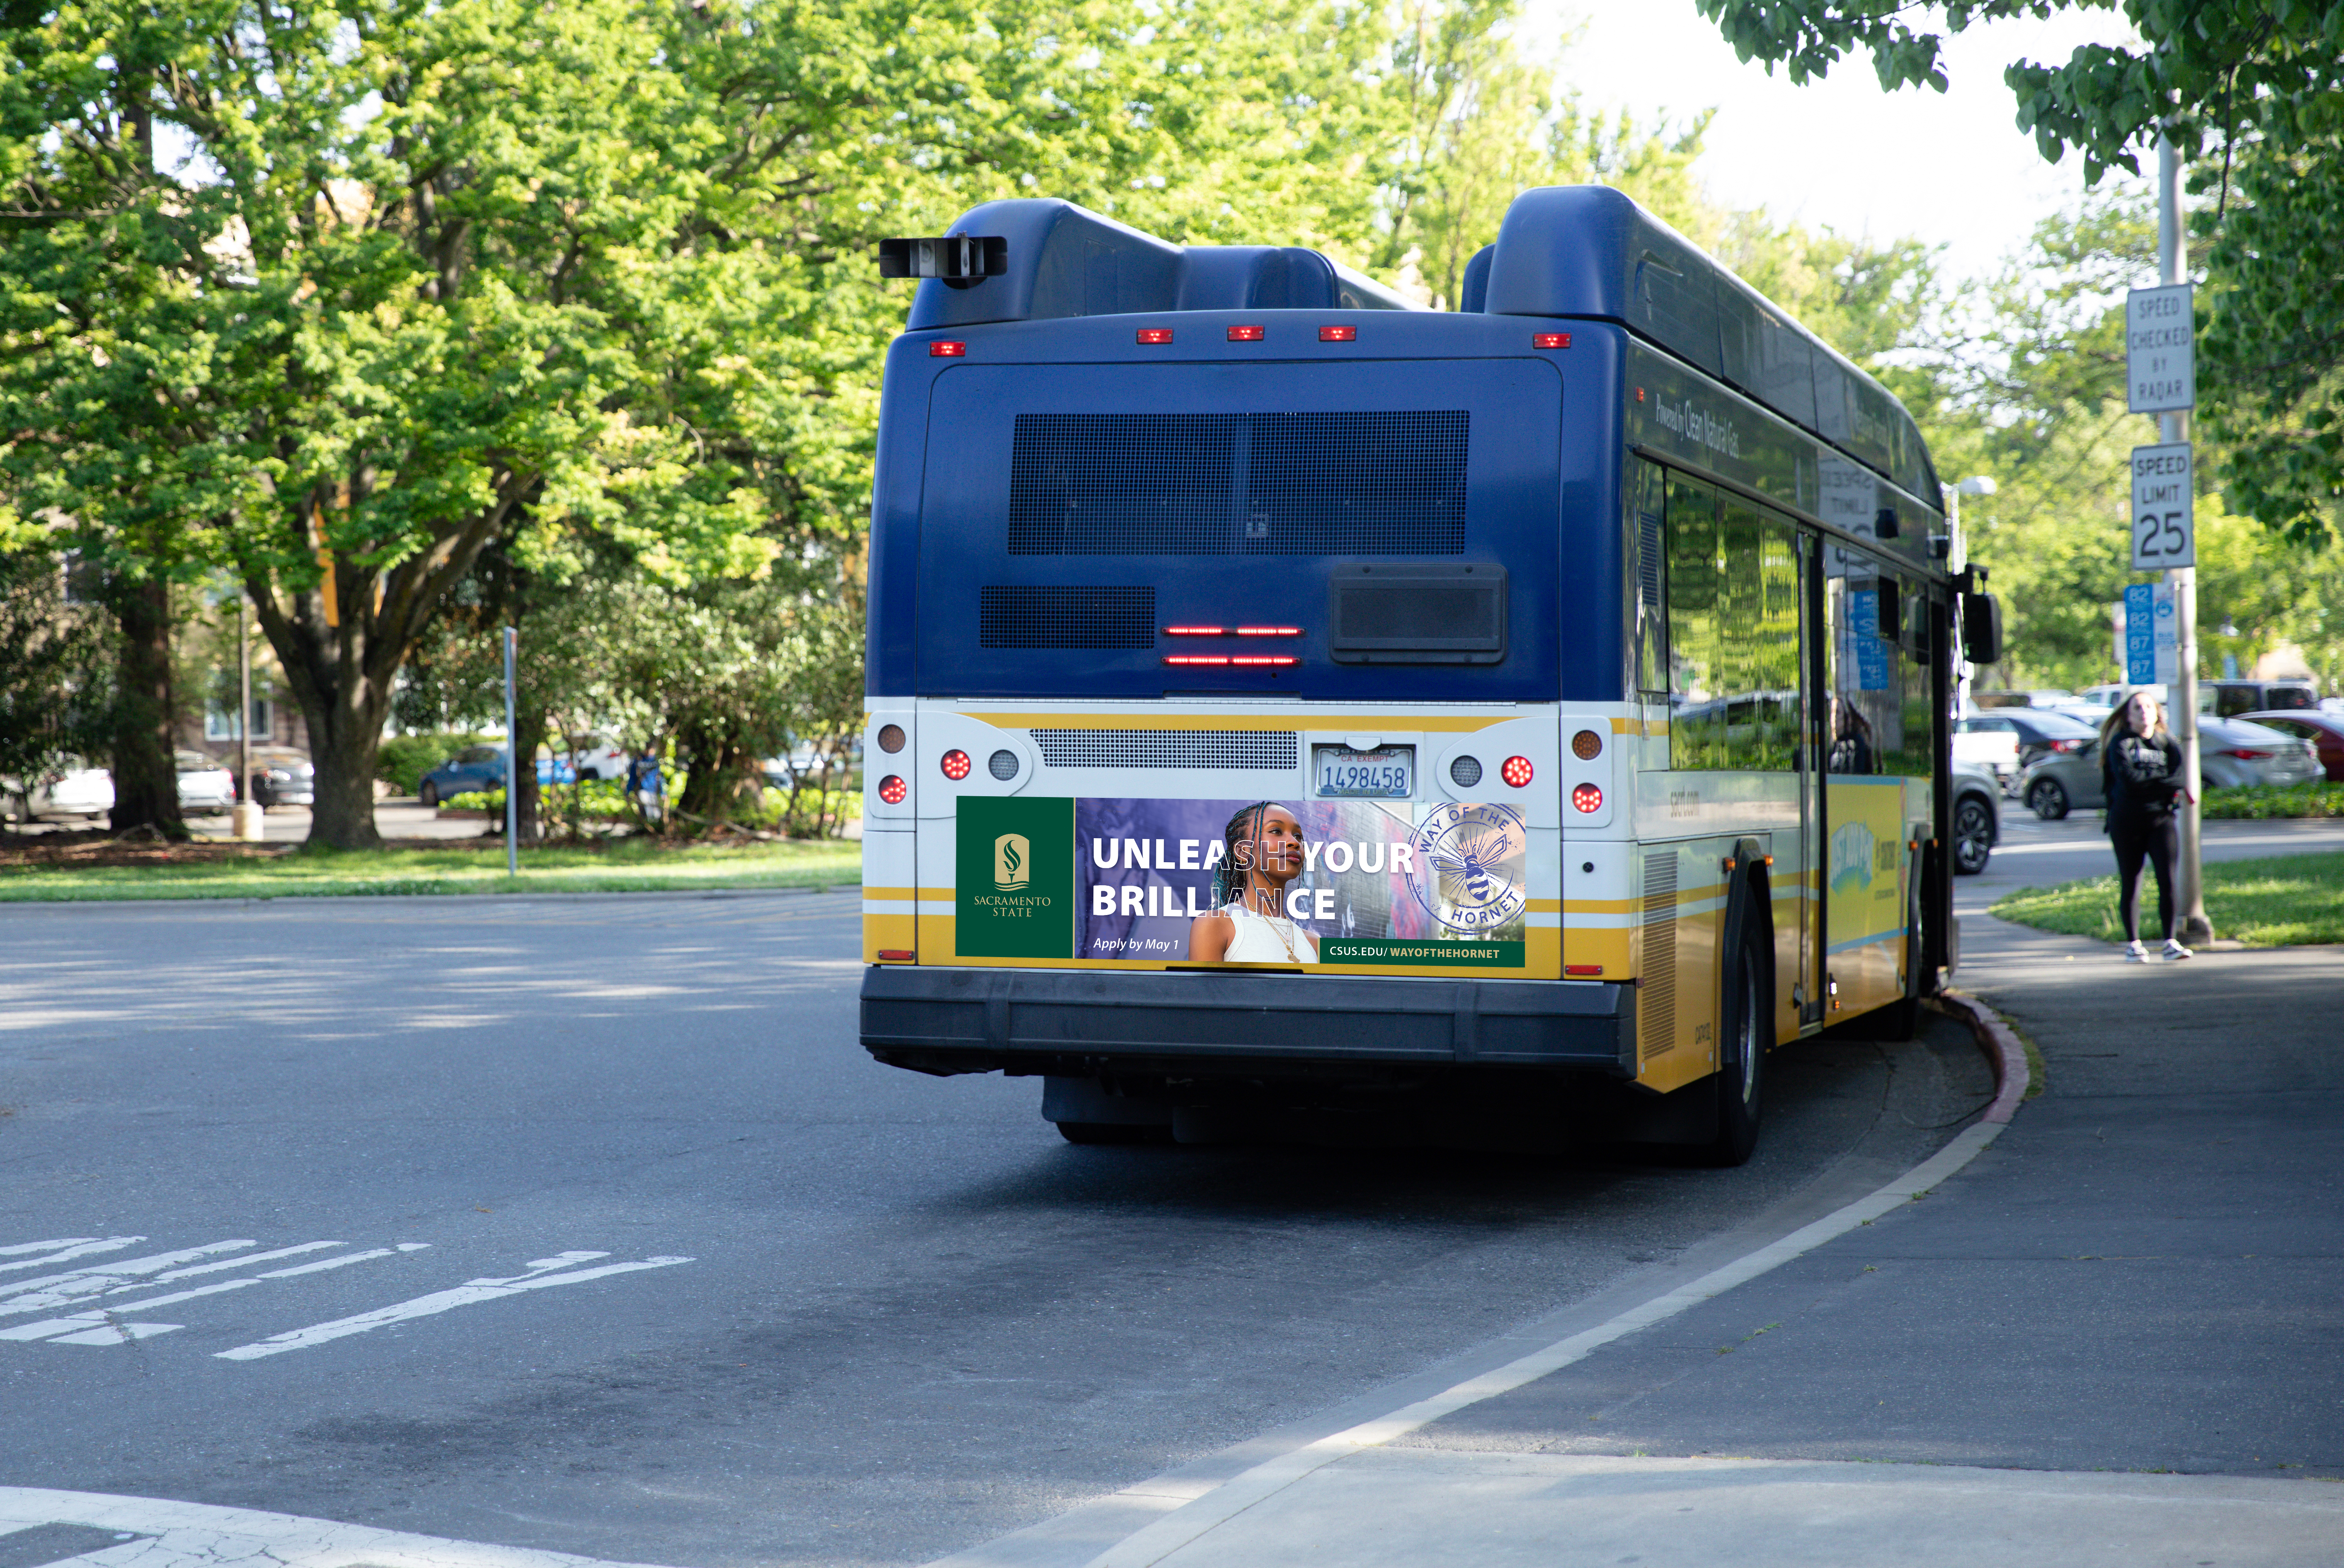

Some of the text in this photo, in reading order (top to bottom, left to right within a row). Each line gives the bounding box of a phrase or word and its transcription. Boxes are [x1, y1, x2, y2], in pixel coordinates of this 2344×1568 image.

[2139, 296, 2180, 319] SPEED
[2132, 326, 2189, 350] CHECKED
[2152, 357, 2167, 373] BY
[2138, 379, 2183, 401] RADAR
[1656, 393, 1739, 459] Powered by Clean Natural Gas
[2137, 456, 2187, 476] SPEED
[2142, 484, 2180, 504] LIMIT
[2140, 512, 2185, 557] 25
[2128, 587, 2150, 603] 82
[2129, 611, 2150, 628] 82
[2129, 636, 2150, 651] 87
[2130, 659, 2151, 675] 87
[1324, 766, 1405, 788] 1498458
[1419, 807, 1510, 853] WAY OF THE
[1093, 838, 1414, 873] UNLEASH YOUR
[974, 896, 1051, 907] SACRAMENTO
[1093, 885, 1336, 920] BRILLIANCE
[1451, 891, 1518, 923] HORNET
[993, 908, 1032, 917] STATE
[1093, 938, 1178, 952] Apply by May 1
